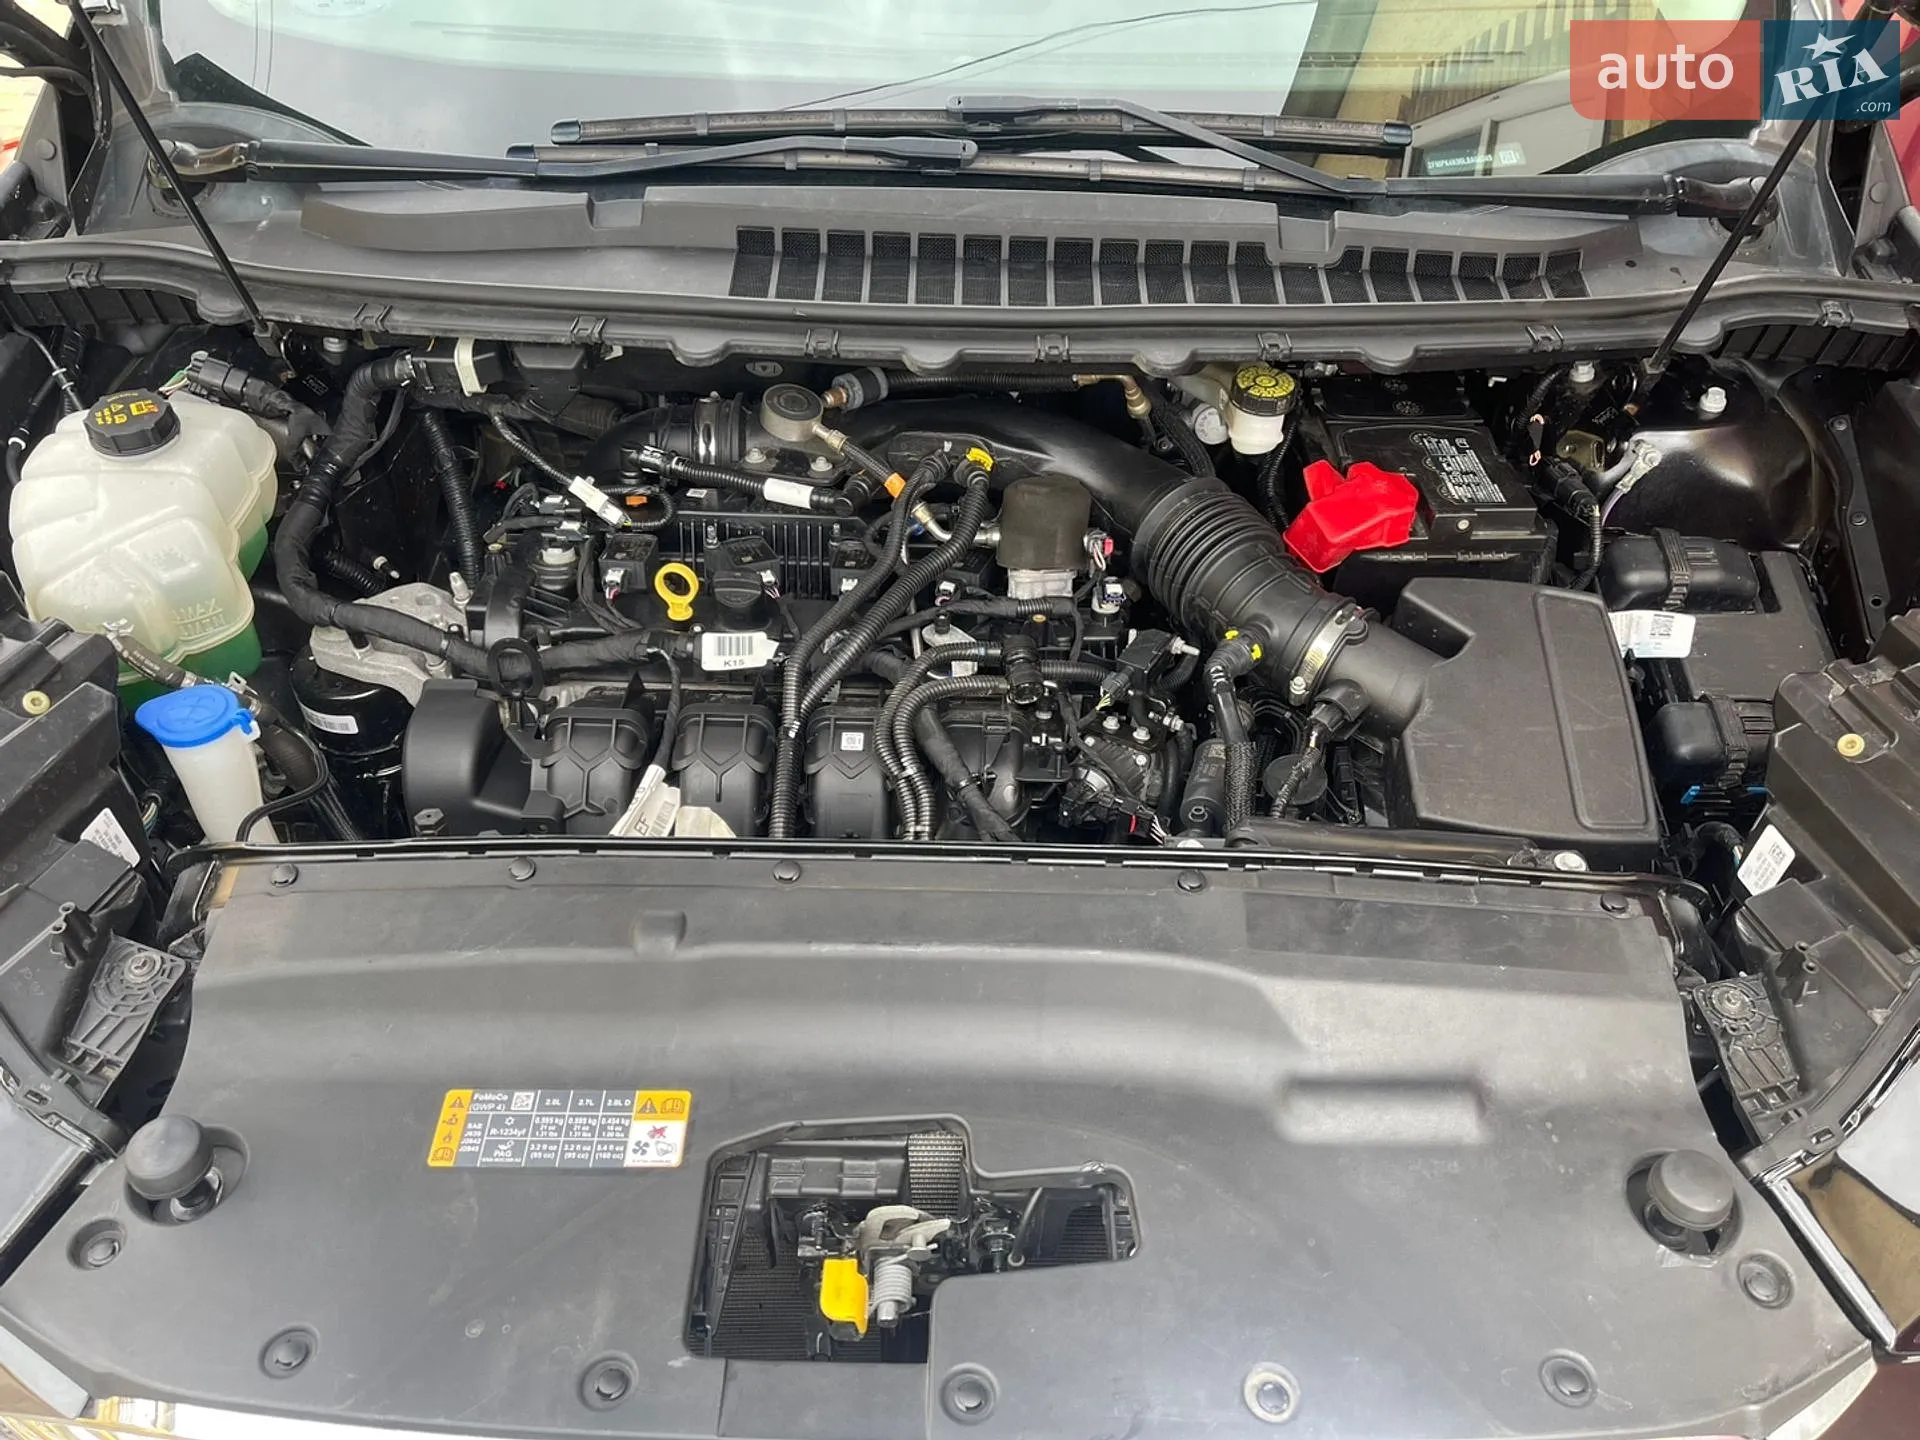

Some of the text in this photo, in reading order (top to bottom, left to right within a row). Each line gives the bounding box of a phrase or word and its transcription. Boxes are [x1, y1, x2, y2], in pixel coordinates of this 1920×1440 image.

[723, 659, 745, 668] K15
[473, 1092, 509, 1101] FoMoCo
[578, 1098, 595, 1106] 2.7L
[469, 1102, 496, 1113] (GWP
[554, 1117, 564, 1126] kg
[588, 1117, 598, 1126] kg
[620, 1117, 630, 1127] kg
[489, 1127, 527, 1137] R-1234yf
